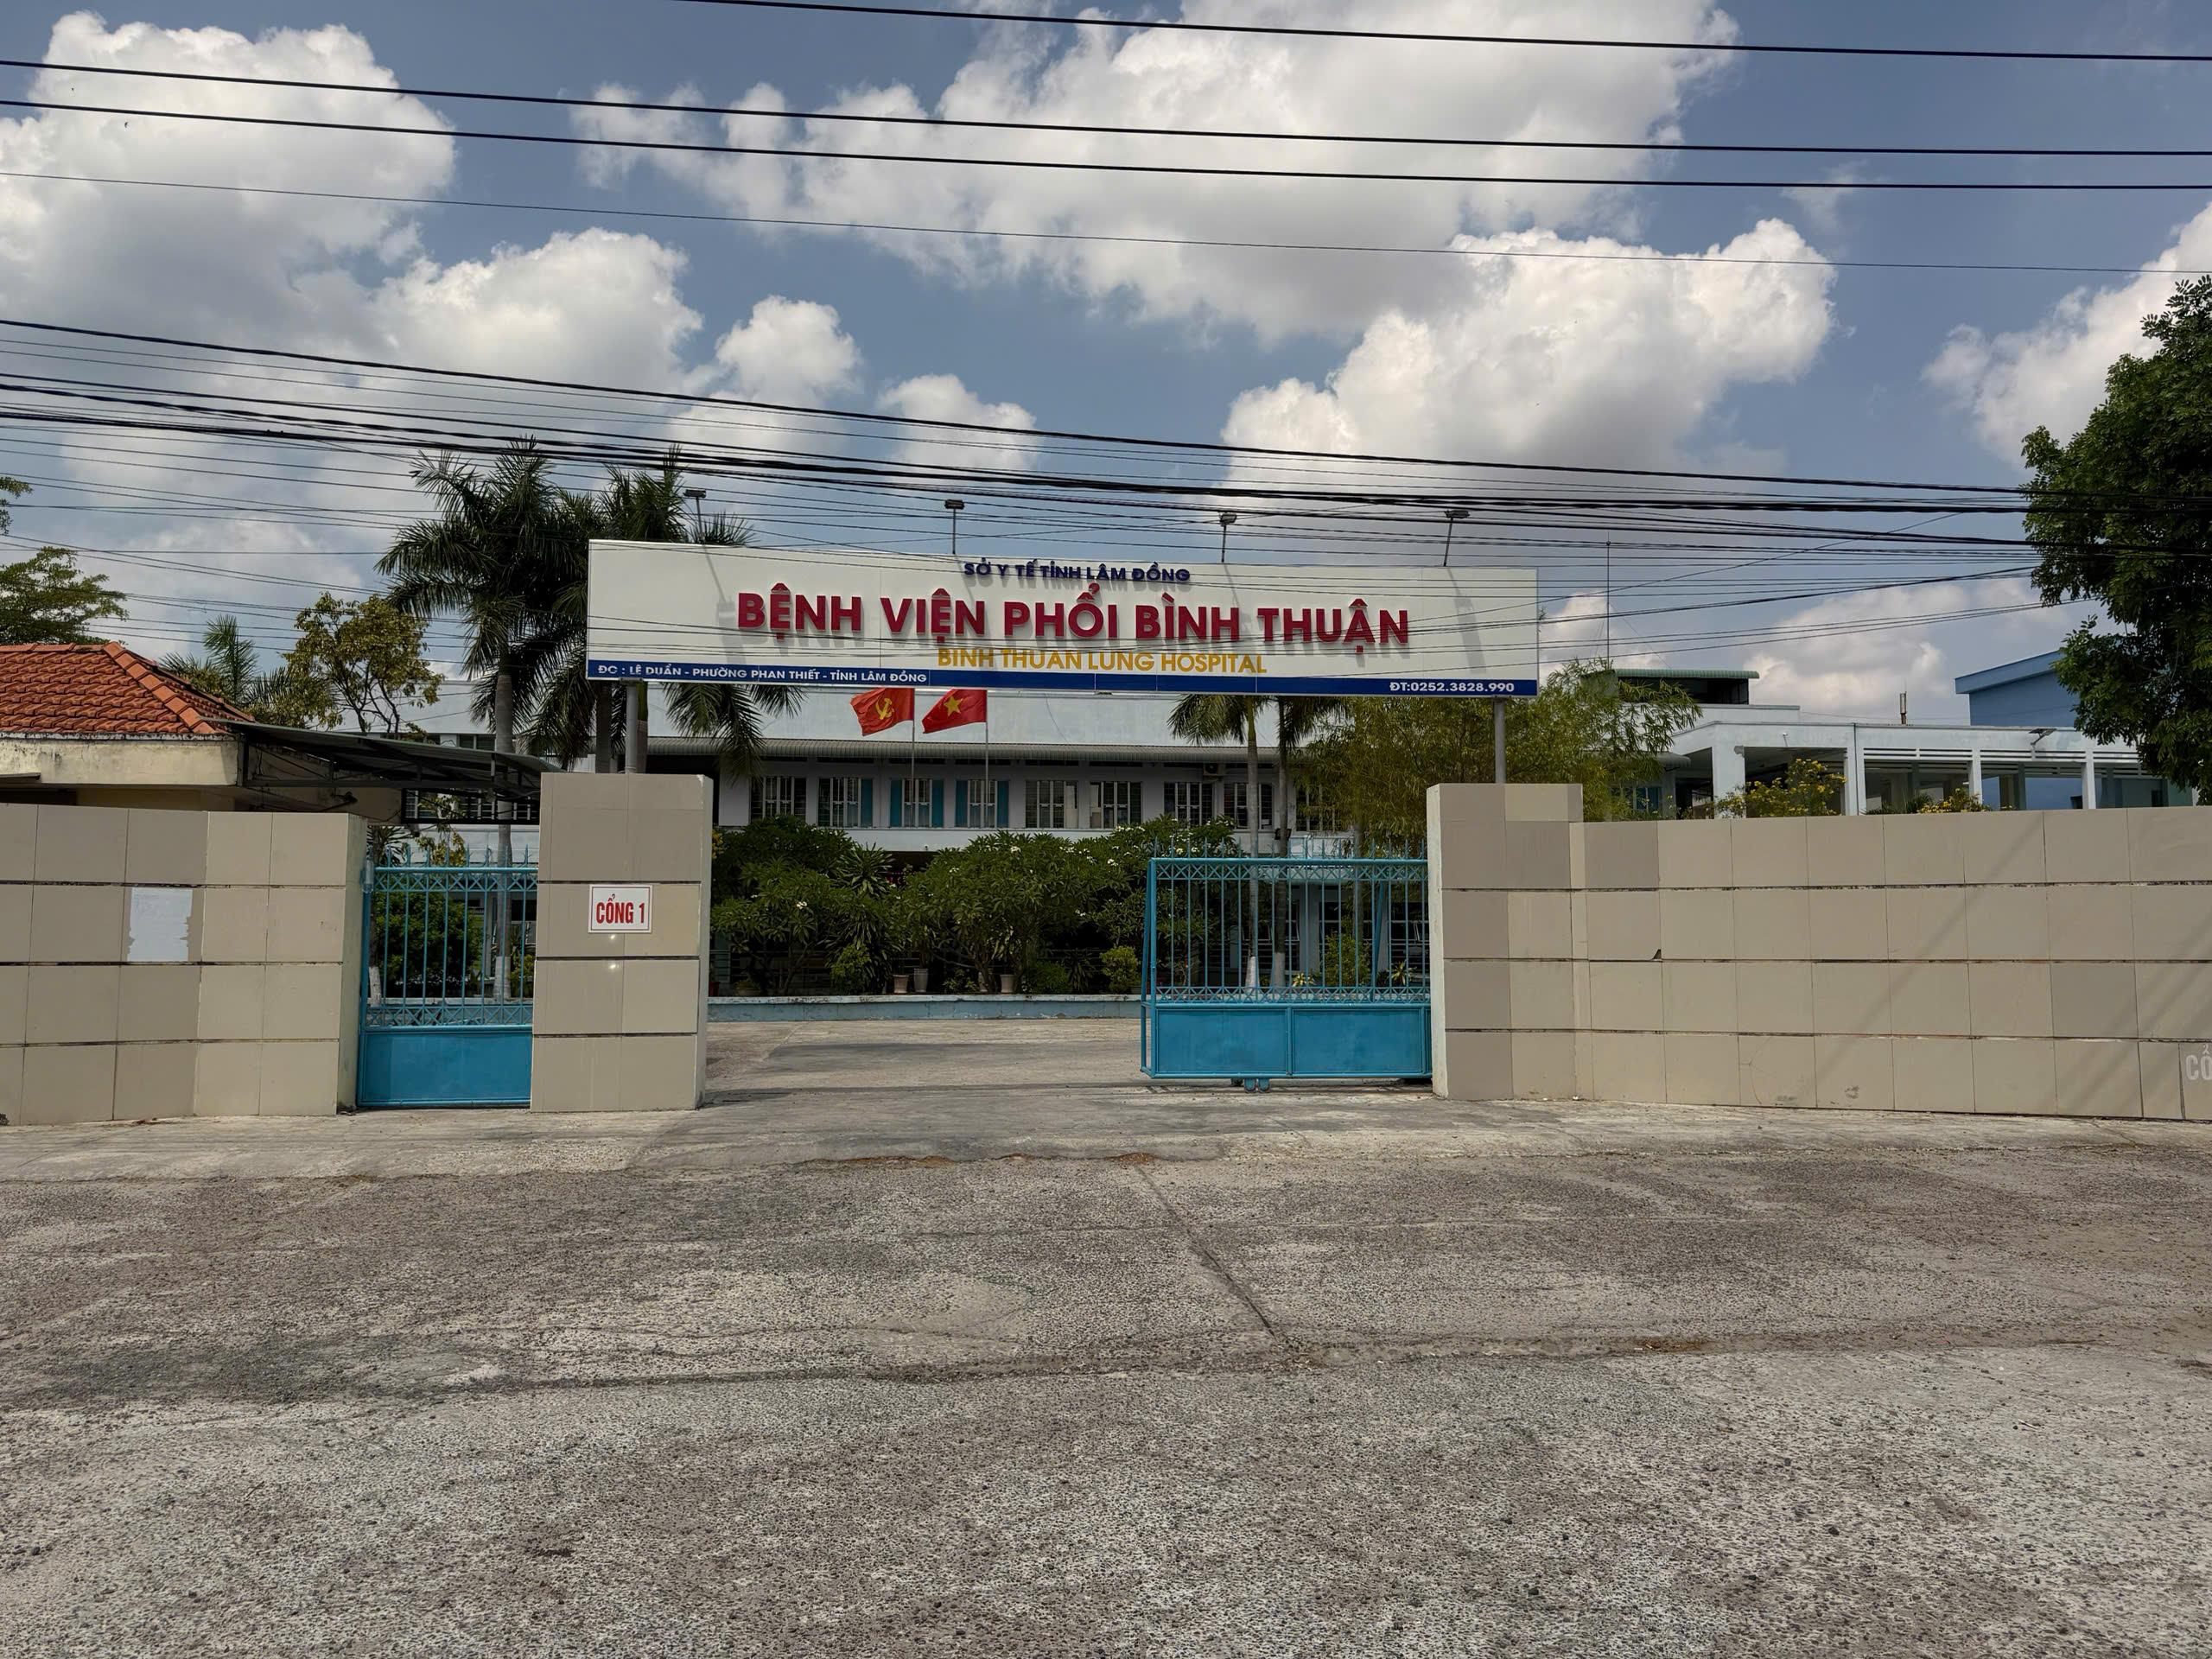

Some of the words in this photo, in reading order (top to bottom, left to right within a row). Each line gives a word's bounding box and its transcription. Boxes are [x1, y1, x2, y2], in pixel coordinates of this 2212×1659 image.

[997, 564, 1008, 576] Y
[1014, 558, 1037, 577] TẾ
[1039, 561, 1080, 579] TỈNH
[1086, 563, 1126, 581] LÂM
[1131, 562, 1191, 582] ĐỒNG
[737, 582, 861, 640] BỆNH
[880, 588, 985, 645] VIỆN
[1003, 582, 1117, 639] PHỔI
[1135, 593, 1239, 641] BÌNH
[1257, 598, 1408, 653] THUẬN
[598, 664, 618, 674] ĐC
[692, 666, 747, 678] PHƯỜNG
[751, 670, 785, 679] PHAN
[789, 669, 820, 680] THIẾT
[861, 671, 886, 682] LÂM
[937, 648, 994, 668] BINH
[999, 649, 1082, 671] THUAN
[1087, 652, 1155, 671] LUNG
[1160, 652, 1268, 674] HOSPITAL
[1389, 682, 1515, 692] ĐT:0252.3828.990
[595, 893, 634, 924] CỔNG
[639, 902, 645, 924] 1
